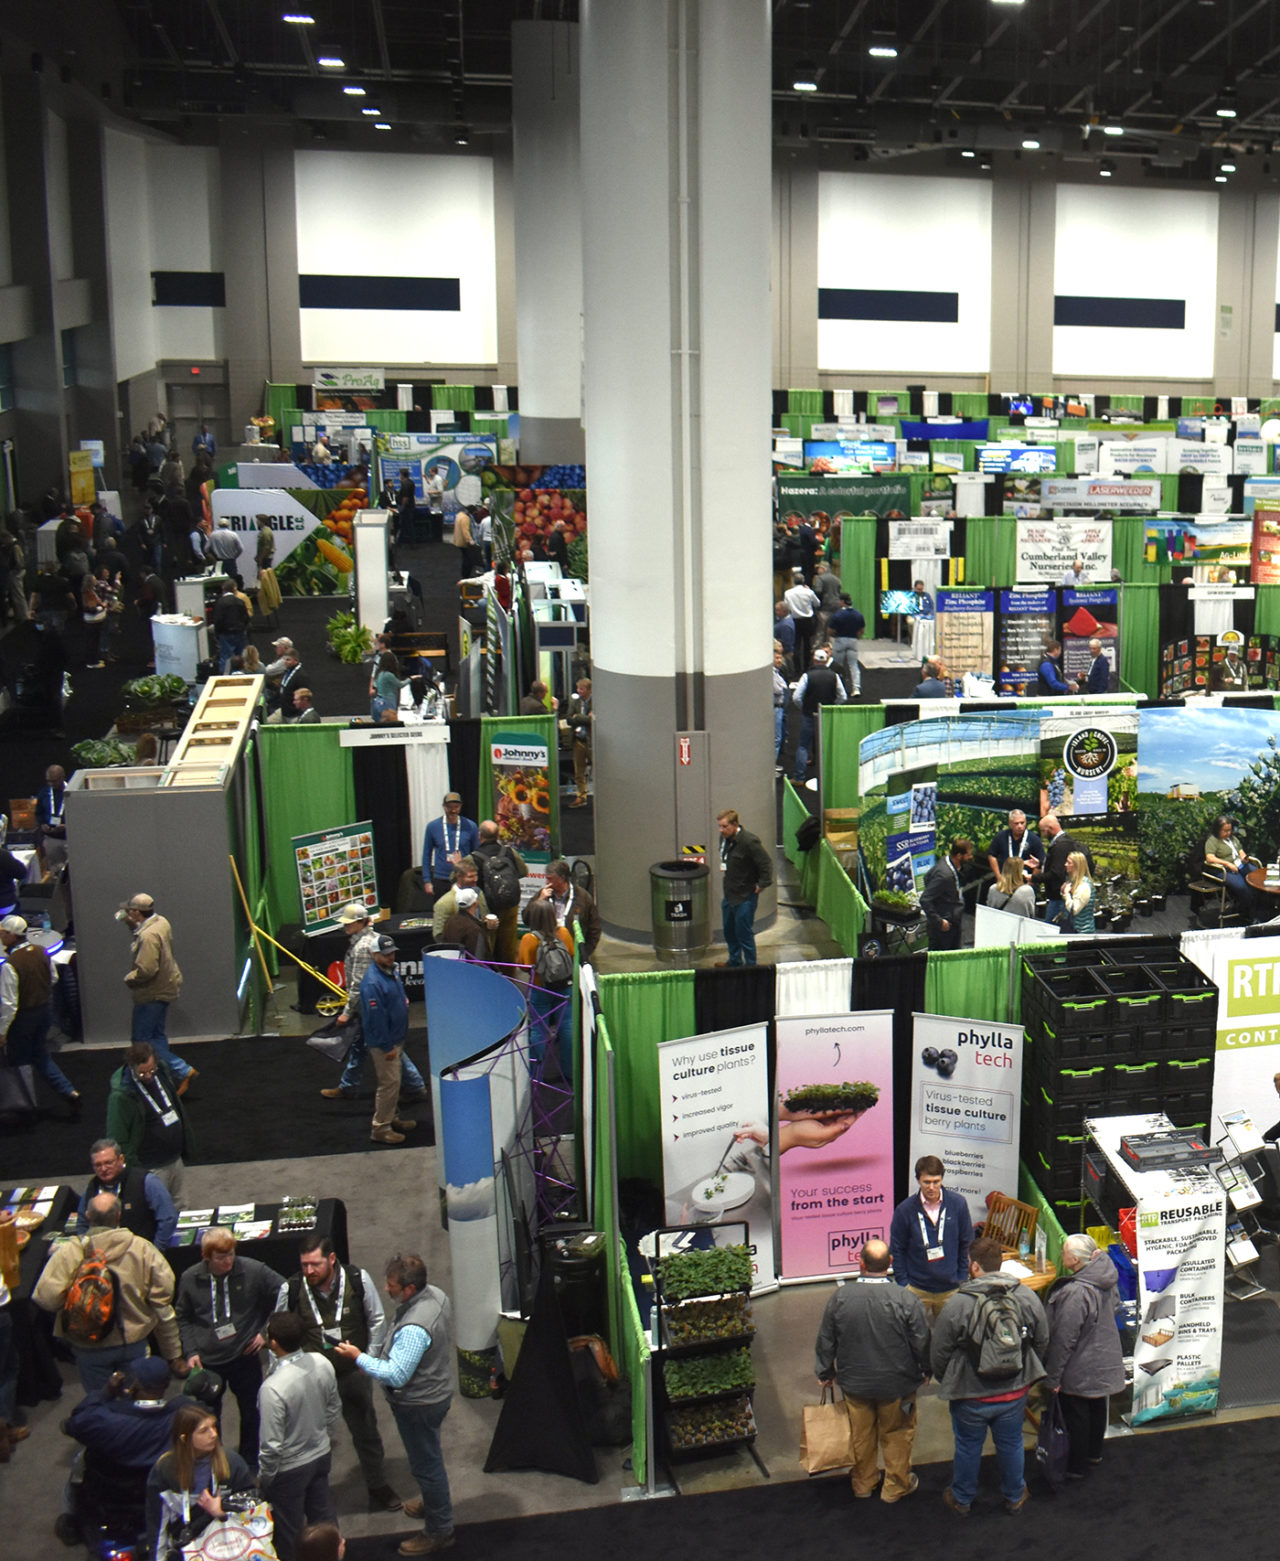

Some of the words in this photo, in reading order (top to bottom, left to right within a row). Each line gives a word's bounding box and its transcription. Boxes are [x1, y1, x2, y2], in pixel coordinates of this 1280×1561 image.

[220, 515, 294, 531] TRIAGLE
[1021, 552, 1078, 561] Cumberland
[1081, 552, 1108, 563] Valley
[1071, 731, 1089, 747] ISLAND
[1093, 730, 1110, 745] GROVE
[502, 748, 546, 760] Johnny's
[1075, 765, 1104, 777] NURSERY
[805, 1025, 865, 1036] phyllatech.com
[957, 1029, 1013, 1050] phylla
[671, 1055, 697, 1068] Why
[698, 1049, 719, 1063] use
[720, 1042, 755, 1057] tissue
[975, 1051, 1013, 1069] tech
[672, 1064, 716, 1081] culture
[716, 1054, 757, 1074] plants?
[681, 1086, 723, 1101] virus-tested
[925, 1089, 993, 1107] Virus-tested
[681, 1107, 716, 1119] increased
[716, 1102, 734, 1113] vigor
[925, 1102, 962, 1116] tissue
[964, 1108, 1007, 1122] culture
[682, 1125, 716, 1139] improved
[716, 1119, 740, 1131] quality
[924, 1115, 952, 1129] berry
[953, 1120, 987, 1132] plants
[944, 1149, 984, 1160] blueberries
[942, 1157, 986, 1169] blackberries
[790, 1187, 819, 1199] Your
[821, 1183, 873, 1196] success
[959, 1186, 982, 1195] more!
[790, 1199, 823, 1212] from
[826, 1196, 849, 1208] the
[852, 1194, 885, 1206] start
[1160, 1201, 1223, 1221] REUSABLE
[1160, 1217, 1193, 1226] TRANSPORT
[1193, 1211, 1223, 1222] PACKAGING
[1141, 1213, 1157, 1225] RTP
[1144, 1236, 1180, 1247] STACKABLE,
[1145, 1243, 1175, 1252] HYGENIC,
[1166, 1244, 1198, 1256] PACKAGING
[1179, 1264, 1217, 1273] CONTAINERS
[1179, 1296, 1216, 1306] CONTAINERS
[1178, 1321, 1212, 1330] HANDHELD
